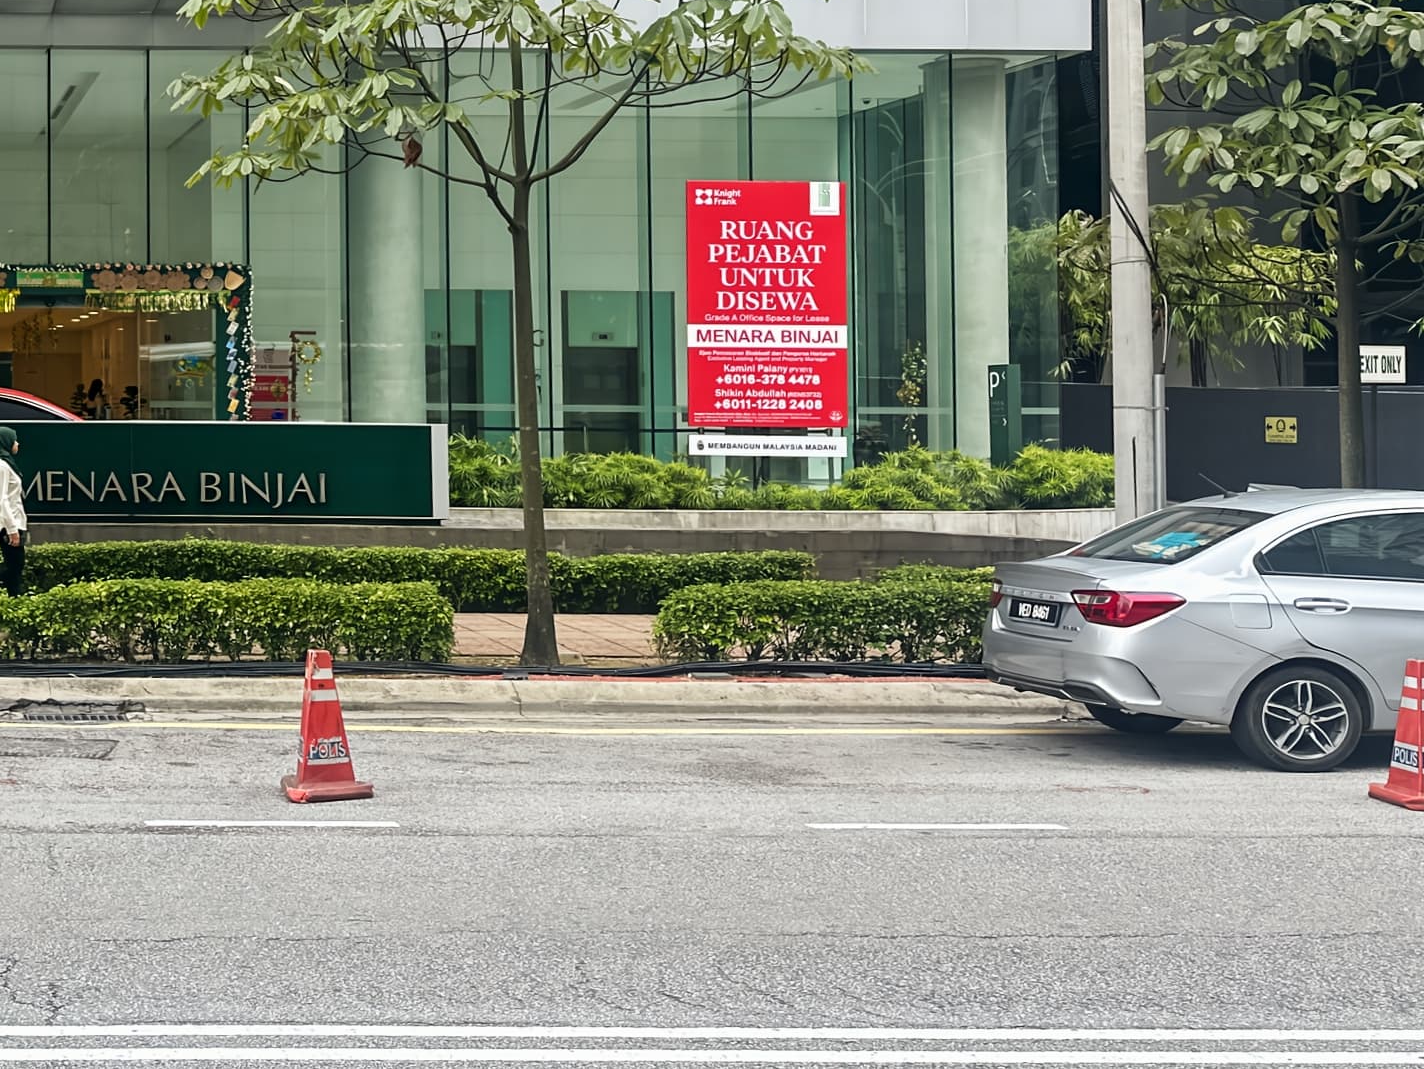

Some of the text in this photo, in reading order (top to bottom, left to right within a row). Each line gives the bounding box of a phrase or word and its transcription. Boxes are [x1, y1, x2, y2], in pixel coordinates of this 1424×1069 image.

[714, 189, 741, 199] Knight
[714, 197, 737, 205] Frank
[720, 221, 814, 240] RUANG
[708, 244, 826, 264] PEJABAT
[720, 268, 815, 287] UNTUK
[716, 291, 819, 311] DISEWA
[704, 314, 729, 322] Grade
[731, 314, 737, 322] A
[739, 314, 764, 322] Office
[765, 314, 791, 324] Space
[793, 314, 803, 322] for
[696, 329, 839, 343] MENARA BINJAI
[1360, 355, 1402, 374] EXIT ONLY
[716, 374, 820, 385] +6016-378 4478
[990, 372, 1000, 398] P
[715, 389, 744, 397] Shikin
[745, 389, 787, 398] Abdullah
[714, 399, 823, 410] +6011-1228 2408
[707, 442, 837, 451] MEMBANGUN MALAYSIA MADANI
[199, 472, 327, 508] BINJAI
[310, 743, 346, 758] POLIS
[1393, 747, 1418, 767] POLIS
